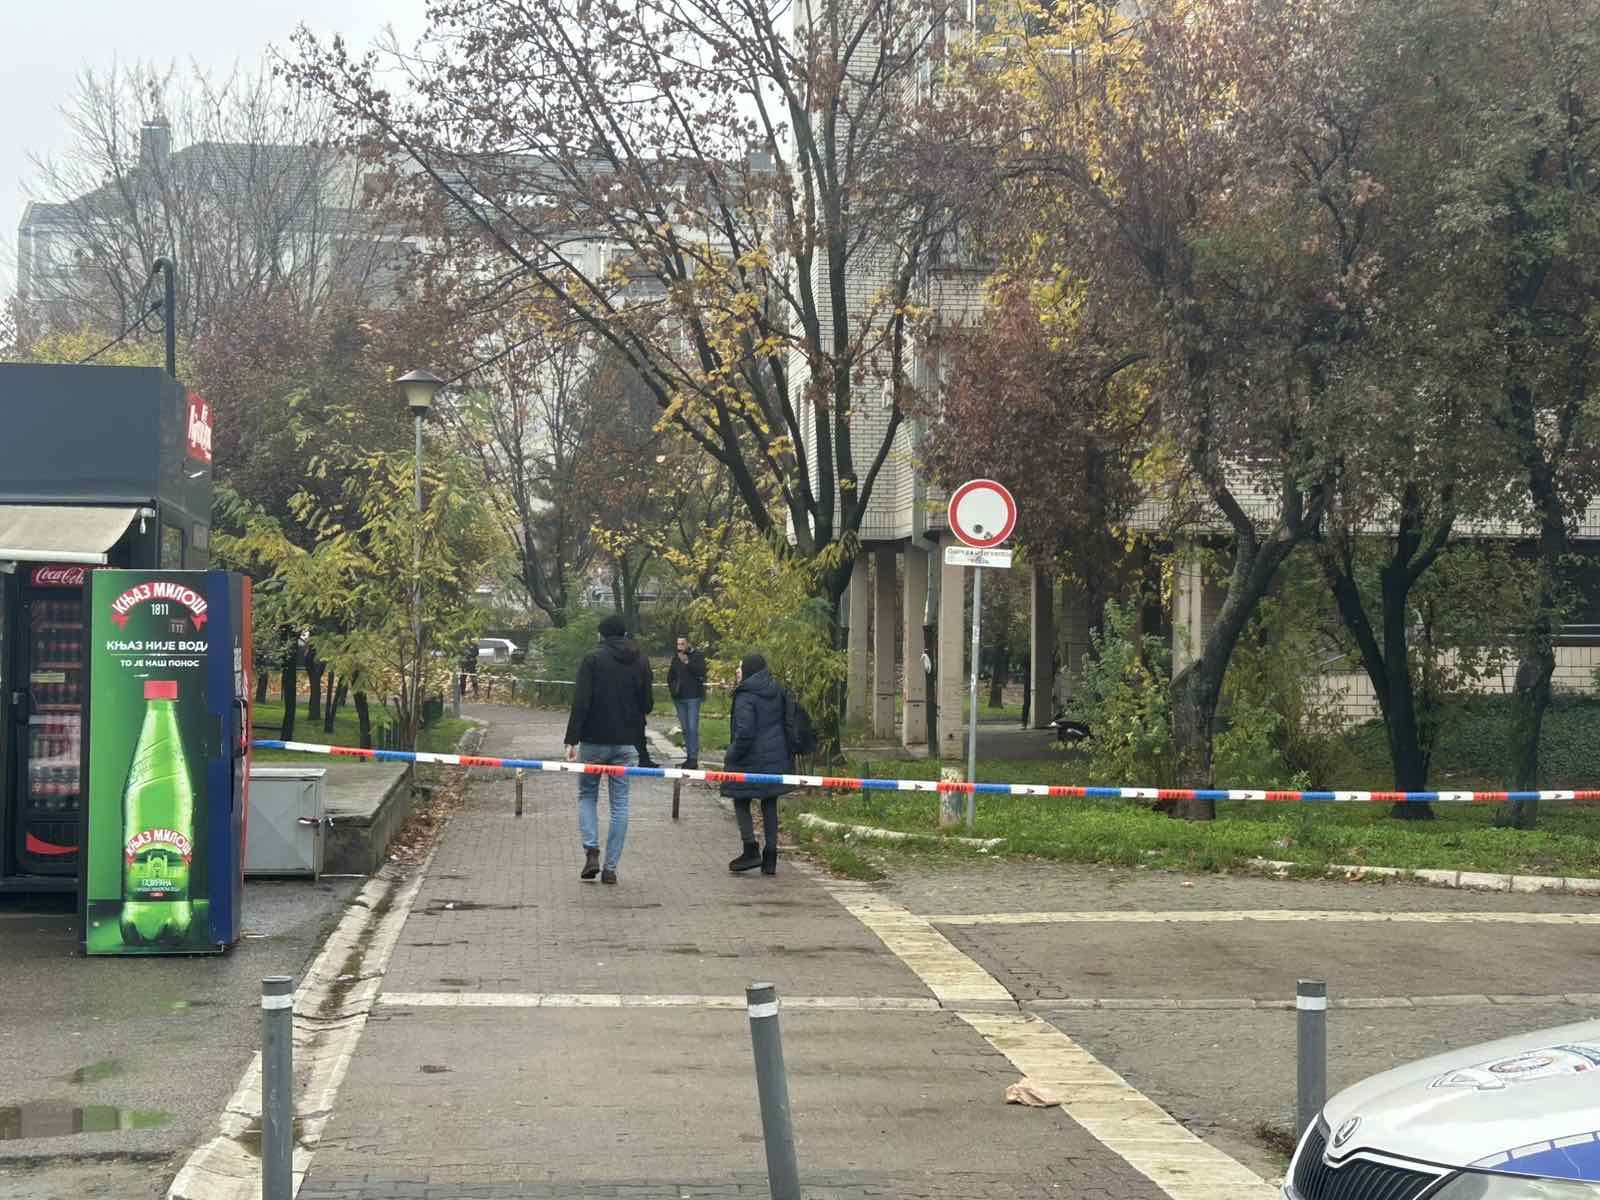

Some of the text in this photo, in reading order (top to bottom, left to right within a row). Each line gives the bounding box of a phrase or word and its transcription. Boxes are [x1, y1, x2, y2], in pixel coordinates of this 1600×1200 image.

[112, 582, 208, 614] КЊАЗ МИЛОШ
[151, 603, 169, 616] 1811
[106, 641, 143, 651] КЊАЗ
[145, 641, 176, 651] НИЈЕ
